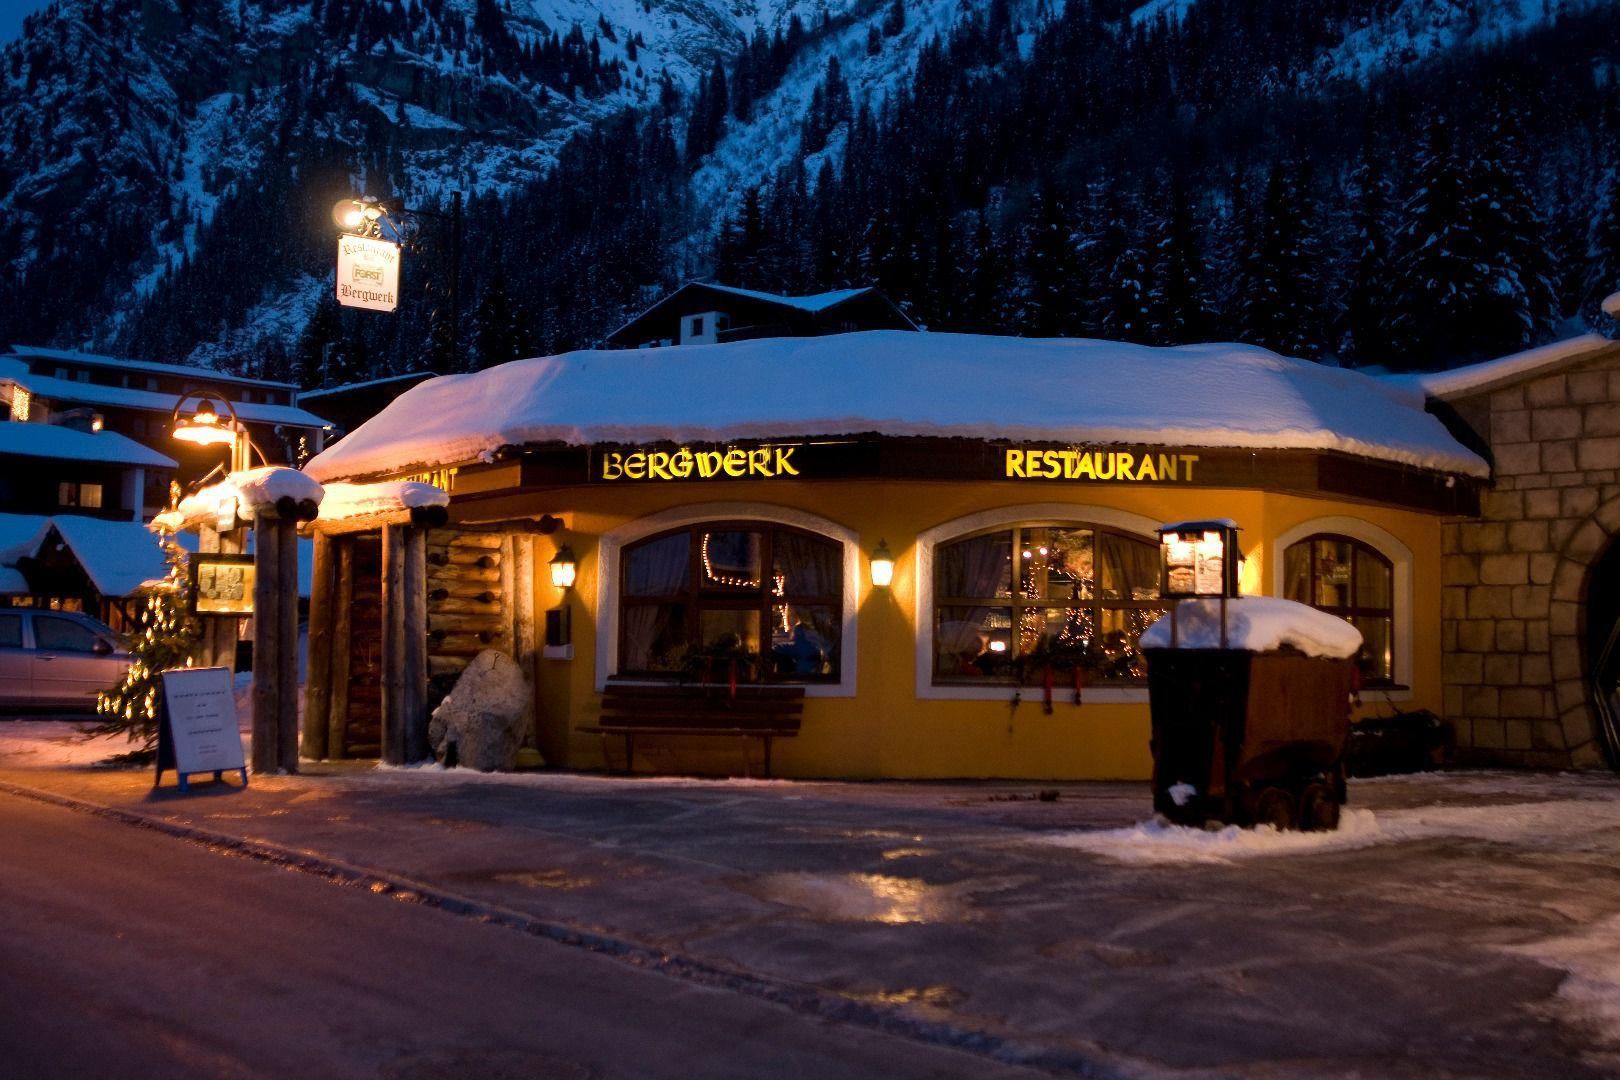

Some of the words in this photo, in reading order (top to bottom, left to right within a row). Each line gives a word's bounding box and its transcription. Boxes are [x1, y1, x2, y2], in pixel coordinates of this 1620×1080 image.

[343, 243, 395, 263] Resturant
[355, 269, 381, 280] FORST
[341, 284, 394, 304] Bergwerk
[602, 447, 800, 480] BERGWERK
[1006, 449, 1199, 481] RESTAURANT
